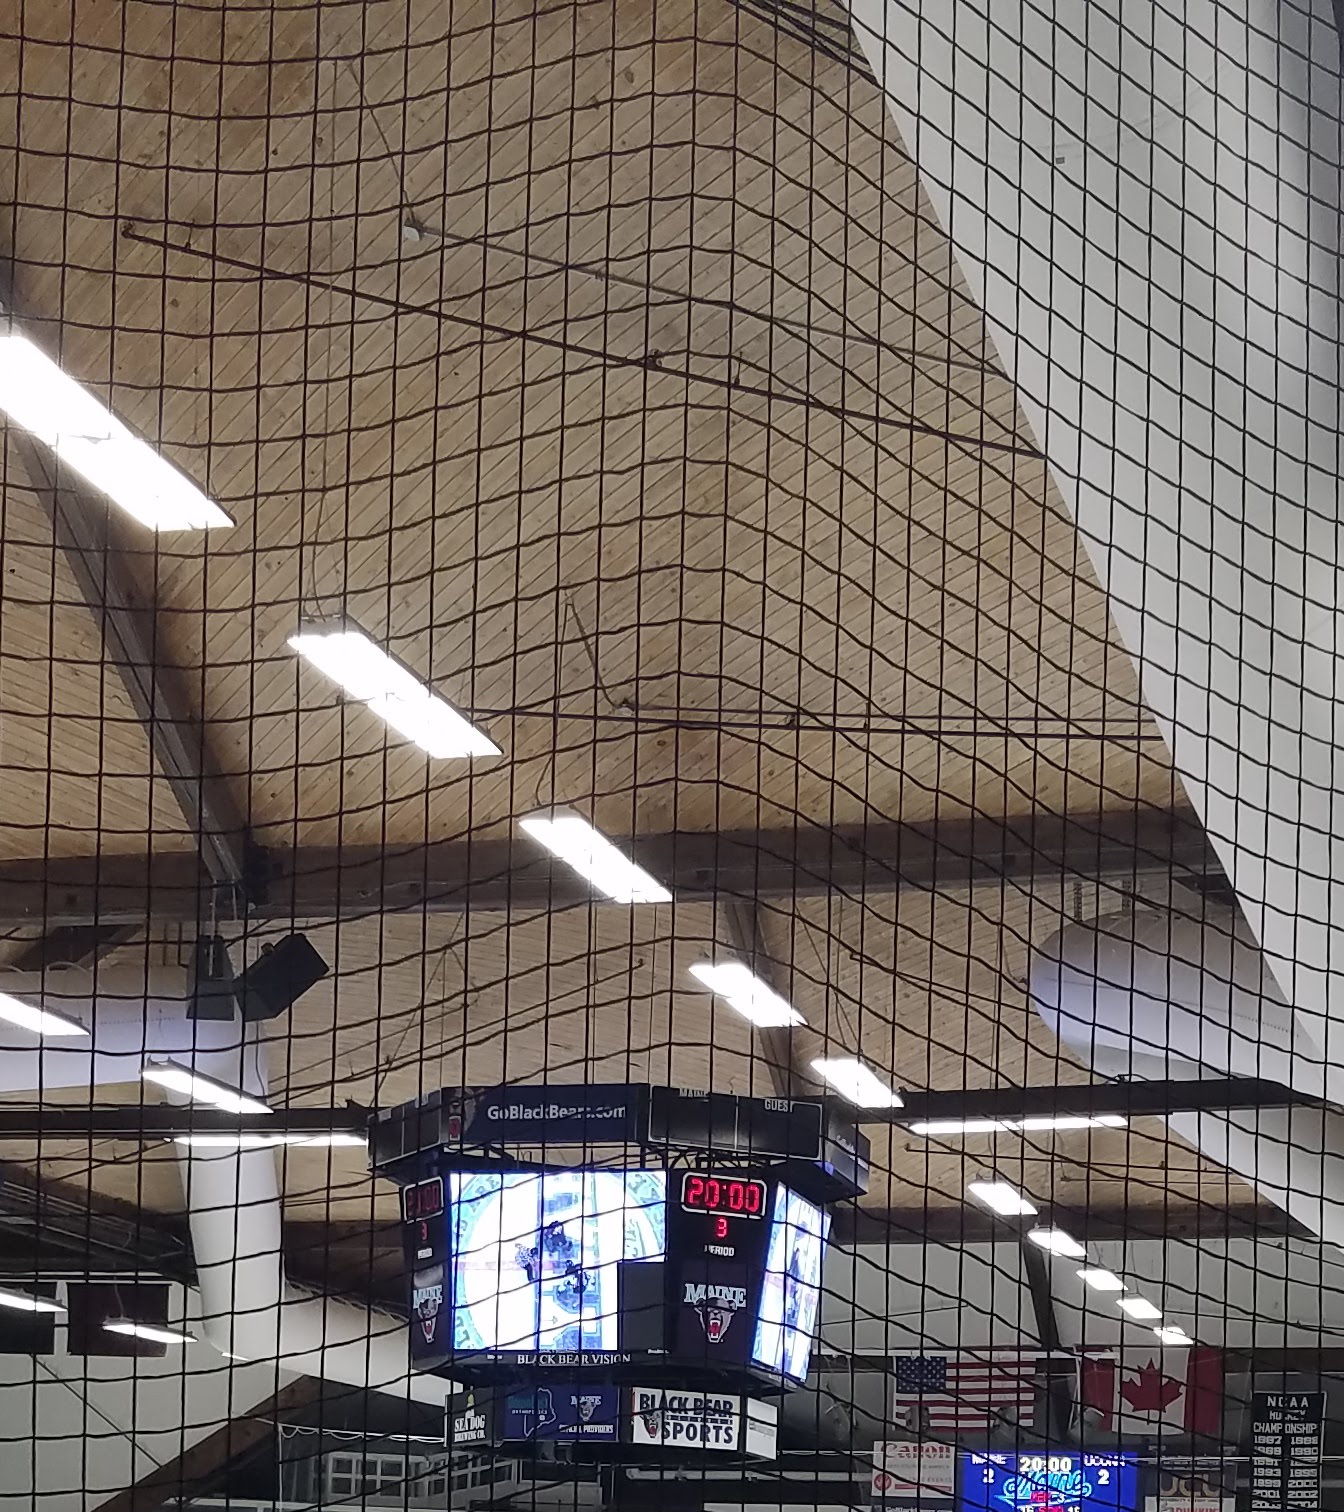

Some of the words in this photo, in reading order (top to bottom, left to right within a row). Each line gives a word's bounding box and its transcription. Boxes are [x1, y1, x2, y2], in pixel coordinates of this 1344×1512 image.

[487, 1103, 626, 1119] GoBlackBear.com
[687, 1178, 761, 1213] 20:00
[716, 1217, 727, 1238] 3
[704, 1244, 735, 1256] ERIOD
[684, 1283, 747, 1309] MAINE
[517, 1353, 555, 1365] BLACK
[558, 1353, 589, 1365] BEAR
[594, 1353, 631, 1365] VISION
[640, 1393, 689, 1415] BLACK
[693, 1398, 734, 1419] BEAR
[455, 1417, 469, 1432] SEA
[470, 1415, 485, 1430] DOG
[1253, 1422, 1318, 1434] CHAMPONSHIP
[664, 1421, 733, 1444] SPORTS
[1019, 1456, 1072, 1472] 20:00
[1097, 1469, 1110, 1484] 2
